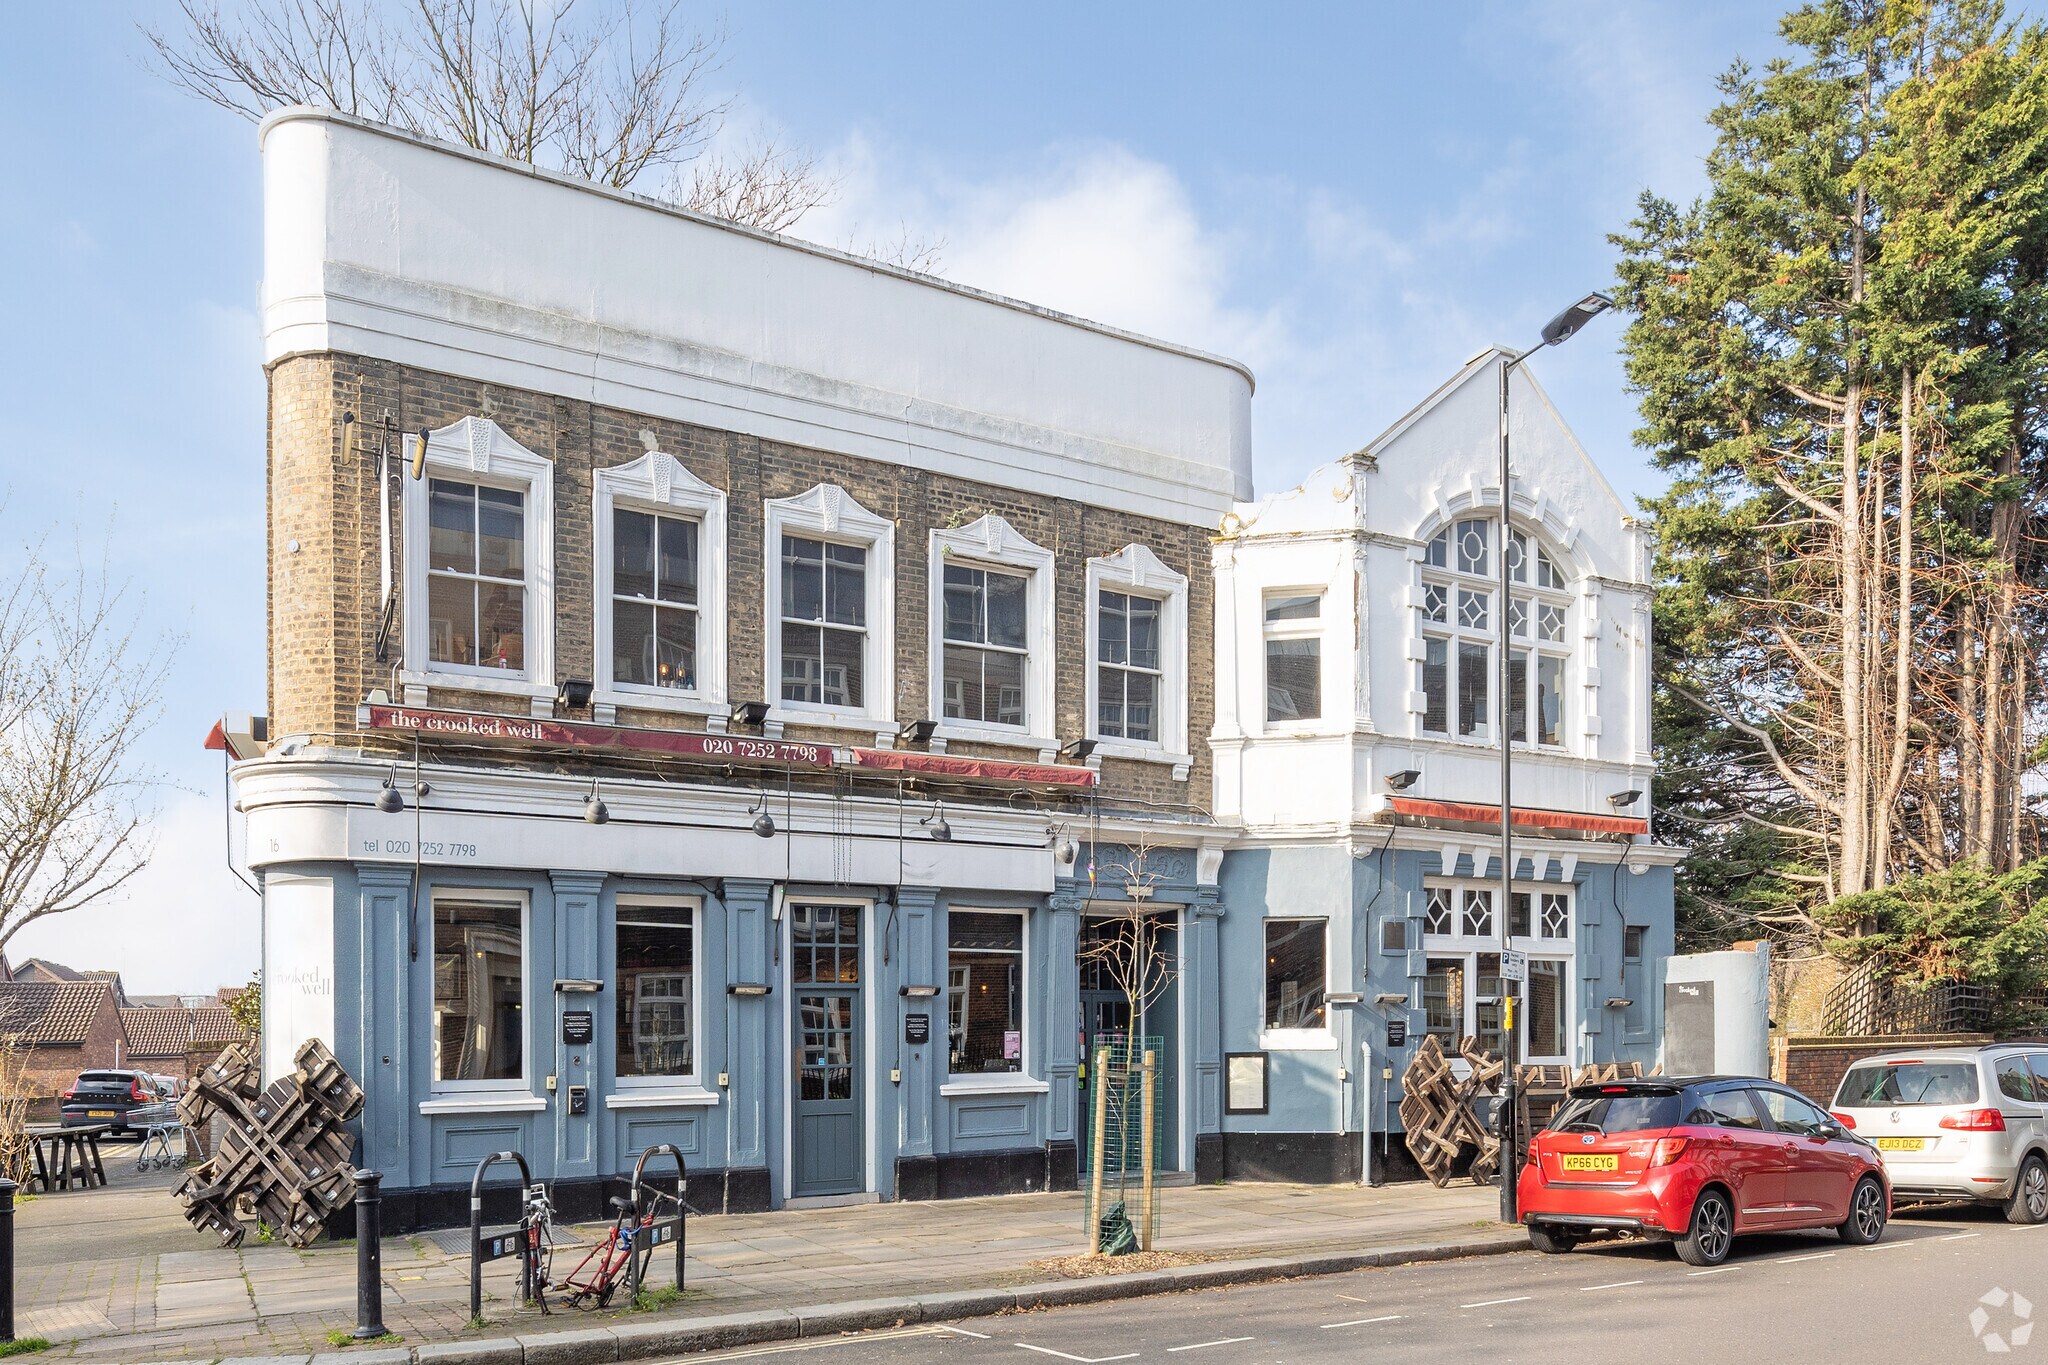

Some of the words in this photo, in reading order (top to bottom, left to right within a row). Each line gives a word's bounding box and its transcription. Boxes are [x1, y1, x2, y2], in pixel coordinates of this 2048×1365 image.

[391, 710, 420, 728] the
[426, 717, 500, 735] crooked
[506, 724, 542, 740] well
[703, 738, 732, 753] 020
[738, 742, 775, 758] 7252
[781, 745, 817, 762] 7798
[270, 838, 280, 853] 16
[364, 840, 379, 852] tel
[386, 840, 411, 854] 020
[449, 843, 476, 857] 7798
[302, 978, 330, 995] well
[1879, 1139, 1900, 1149] EJ13
[1567, 1157, 1592, 1168] KP66
[1594, 1158, 1613, 1168] CYG
